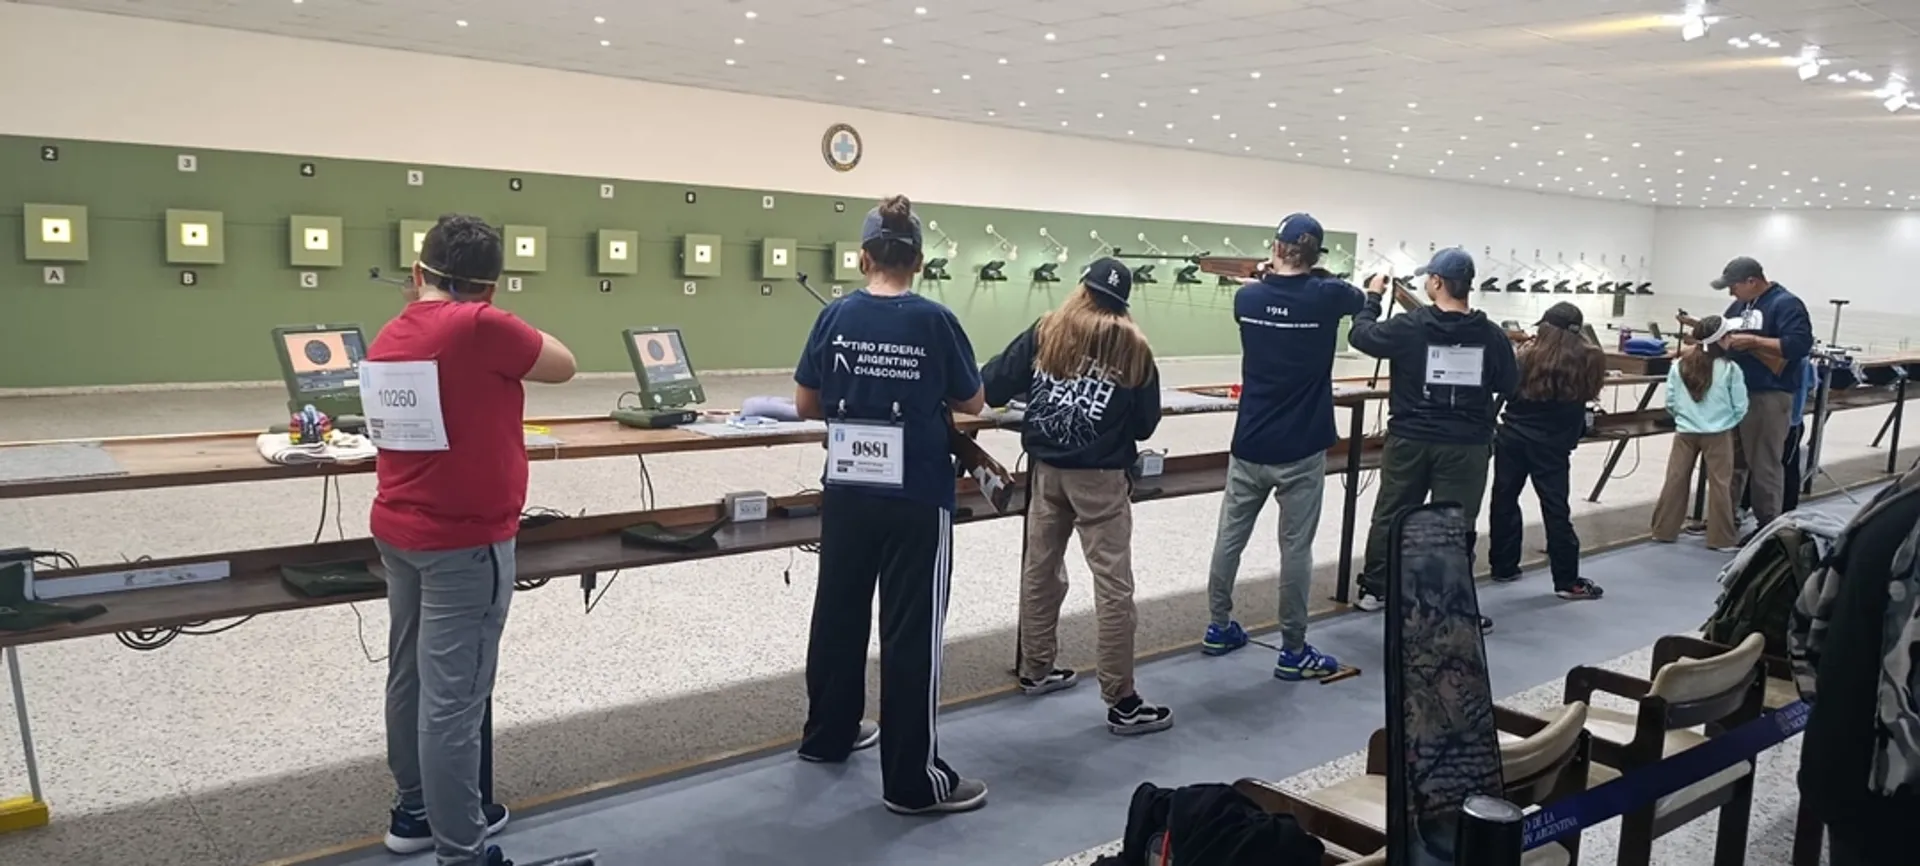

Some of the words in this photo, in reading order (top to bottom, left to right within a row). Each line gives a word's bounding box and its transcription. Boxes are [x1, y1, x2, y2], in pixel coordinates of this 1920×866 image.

[45, 148, 55, 159] 2
[303, 165, 313, 175] 4
[49, 270, 61, 281] A
[183, 272, 194, 284] B
[304, 274, 315, 285] C
[851, 341, 876, 352] TIRO
[878, 343, 927, 357] FEDERAL
[857, 354, 919, 368] ARGENTINO
[853, 366, 921, 380] CHASCOMÚS
[378, 389, 417, 407] 10260
[1048, 385, 1107, 420] FACE
[851, 441, 889, 459] 9881
